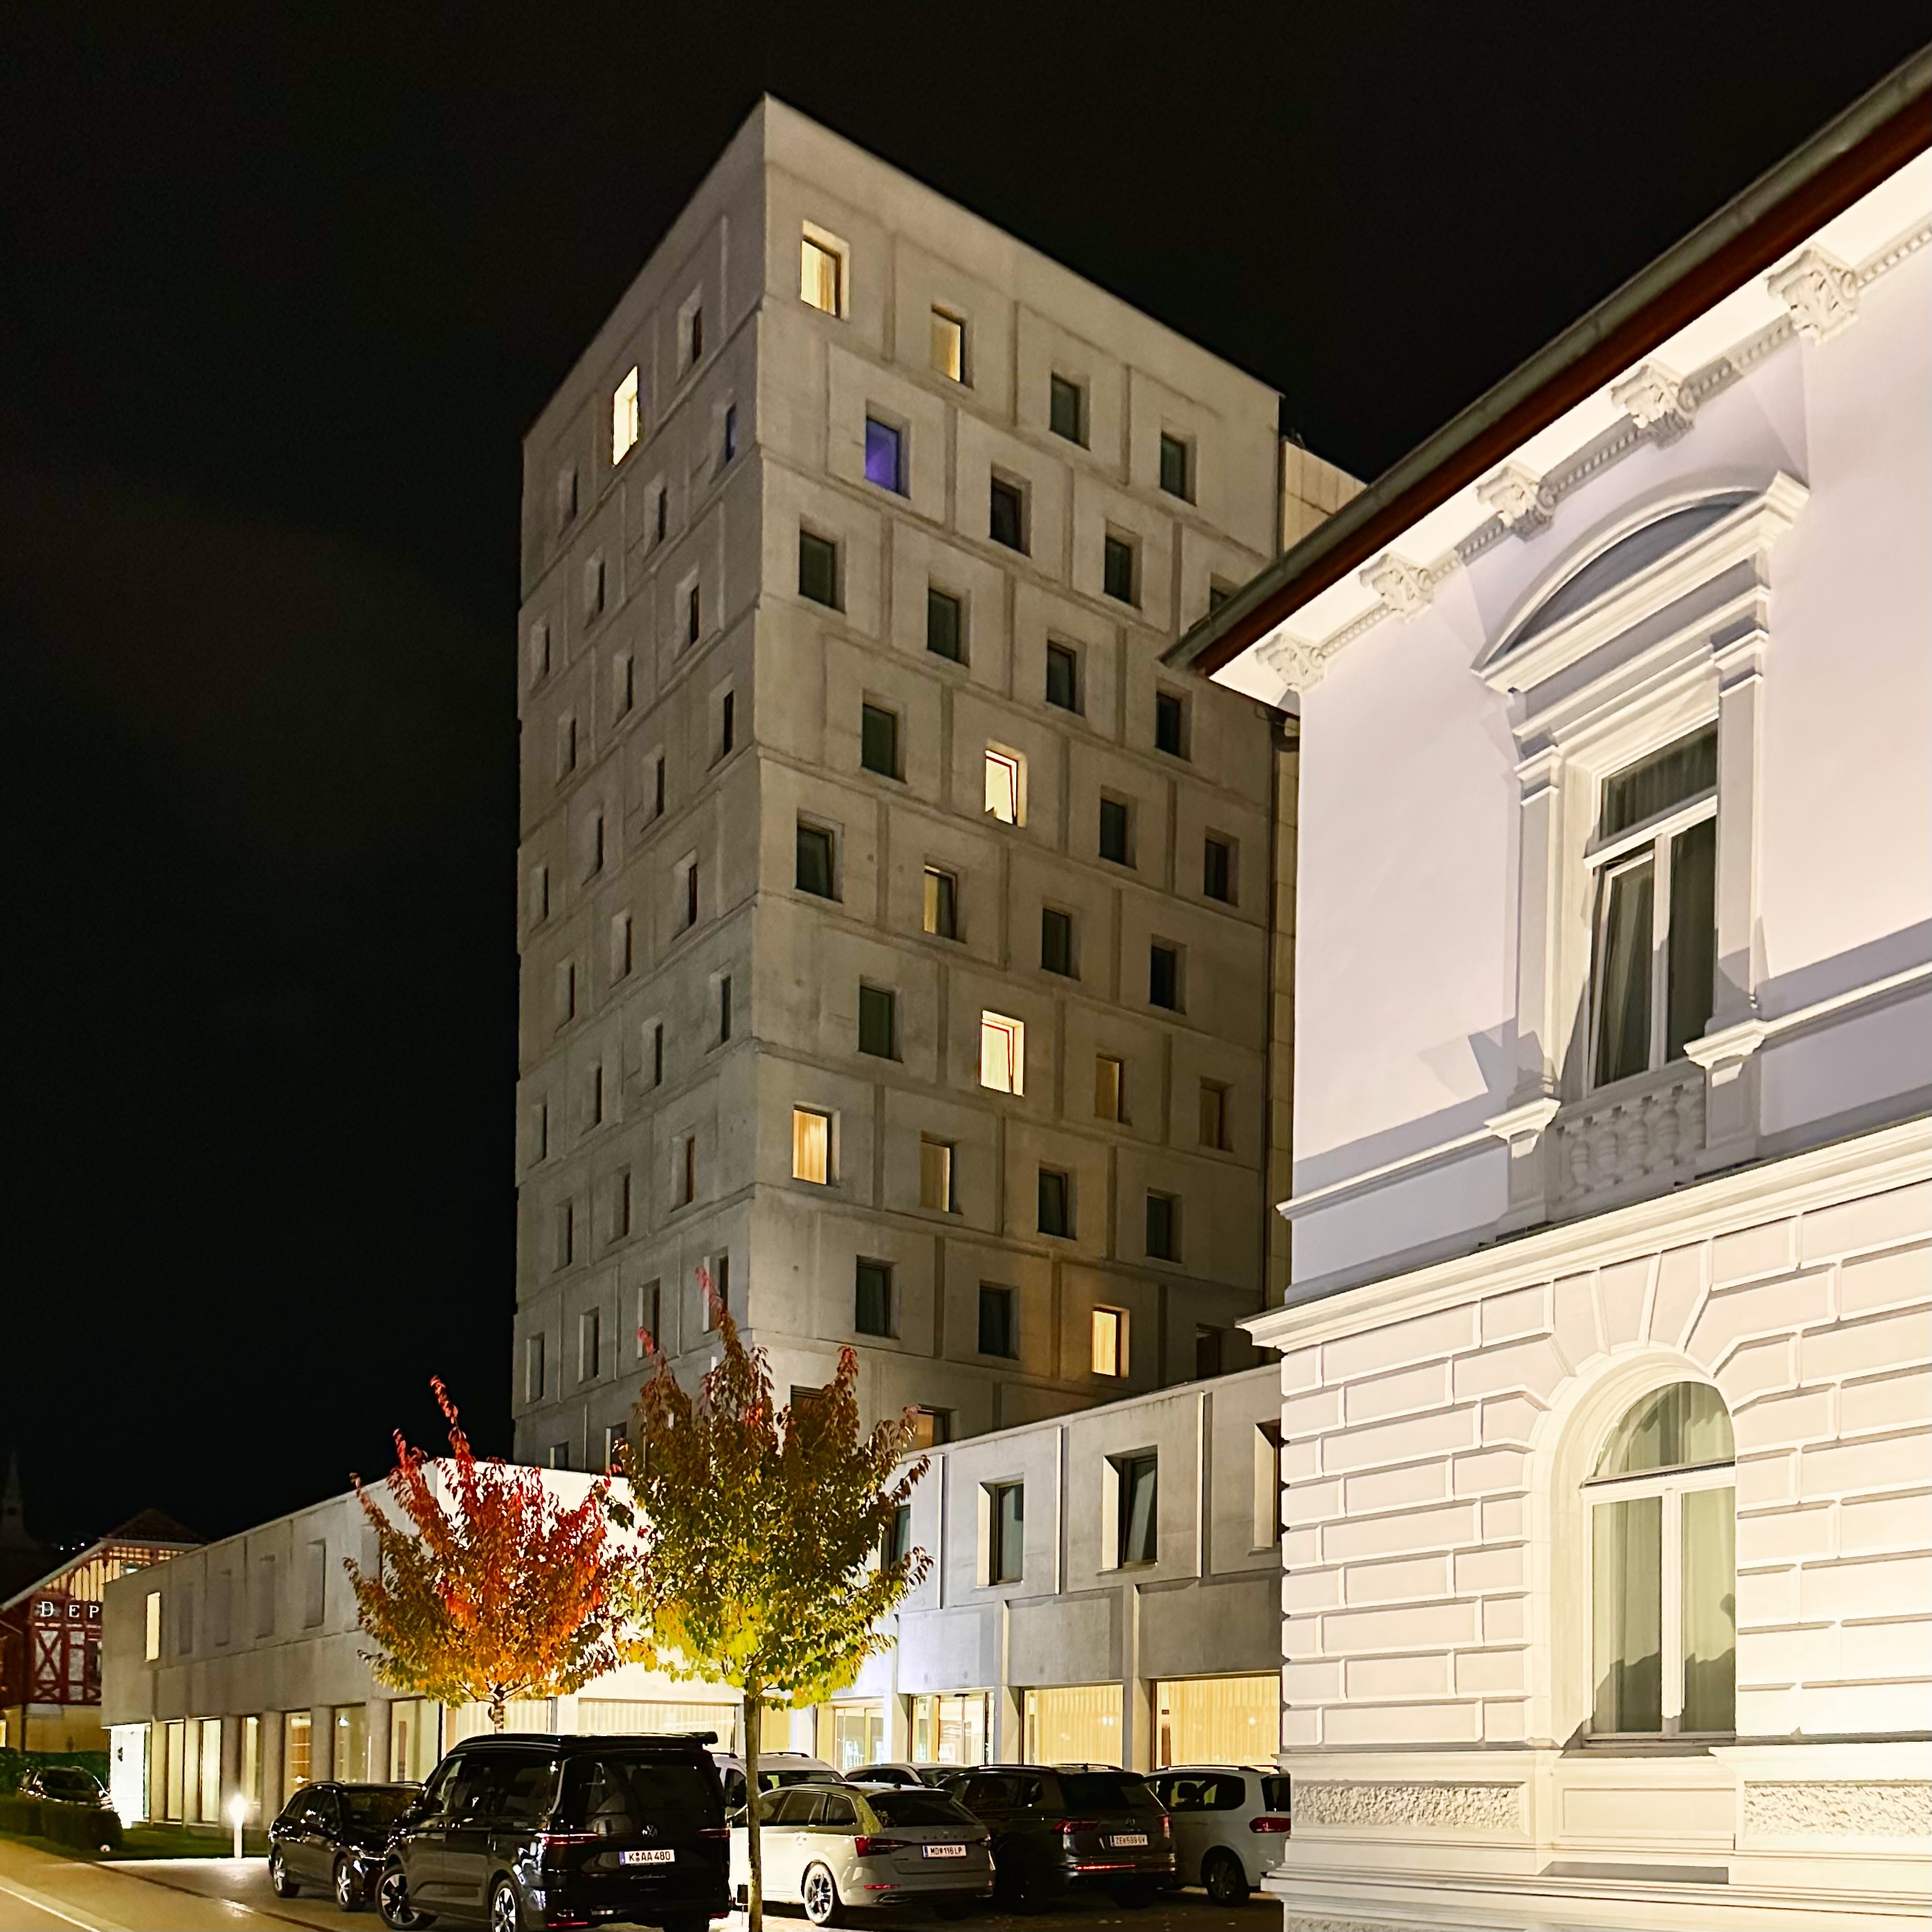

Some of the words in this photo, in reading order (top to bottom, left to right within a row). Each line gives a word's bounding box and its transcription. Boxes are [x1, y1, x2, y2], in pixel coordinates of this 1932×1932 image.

[629, 1853, 635, 1861] K
[642, 1852, 652, 1861] AA
[655, 1851, 671, 1860] 480
